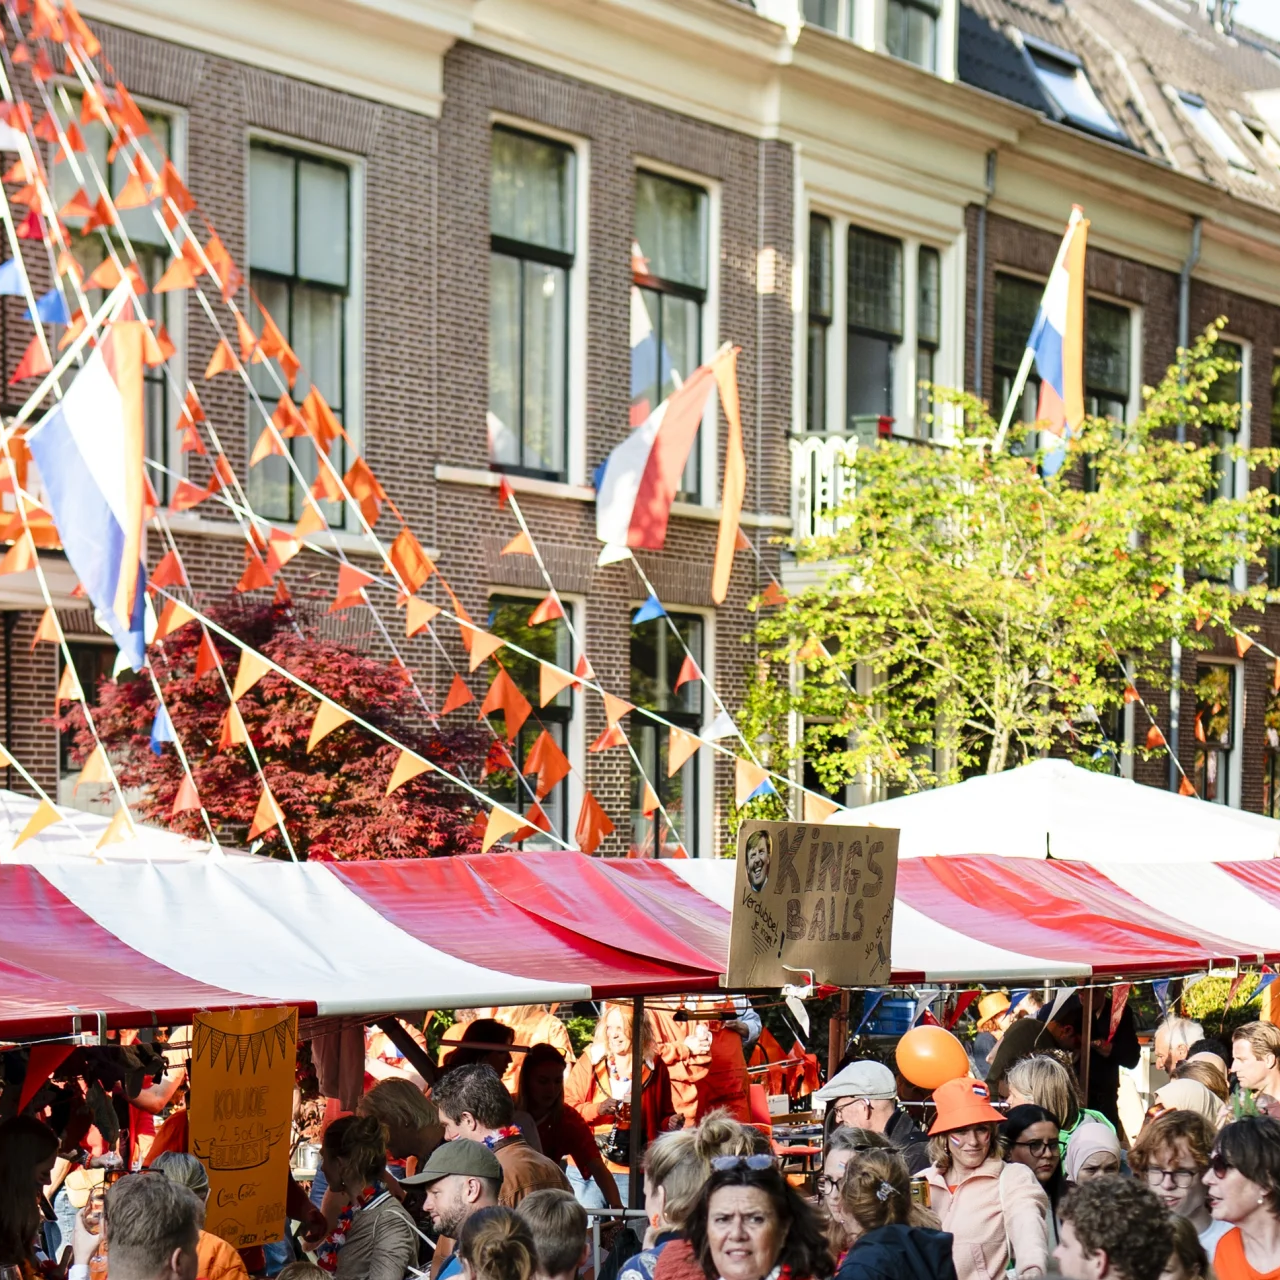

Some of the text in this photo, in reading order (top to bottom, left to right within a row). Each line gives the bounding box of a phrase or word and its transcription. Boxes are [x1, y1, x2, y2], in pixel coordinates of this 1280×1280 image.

[785, 896, 865, 942] BALLS
[213, 1086, 269, 1121] KOUDE
[217, 1182, 262, 1208] Coca-Cola
